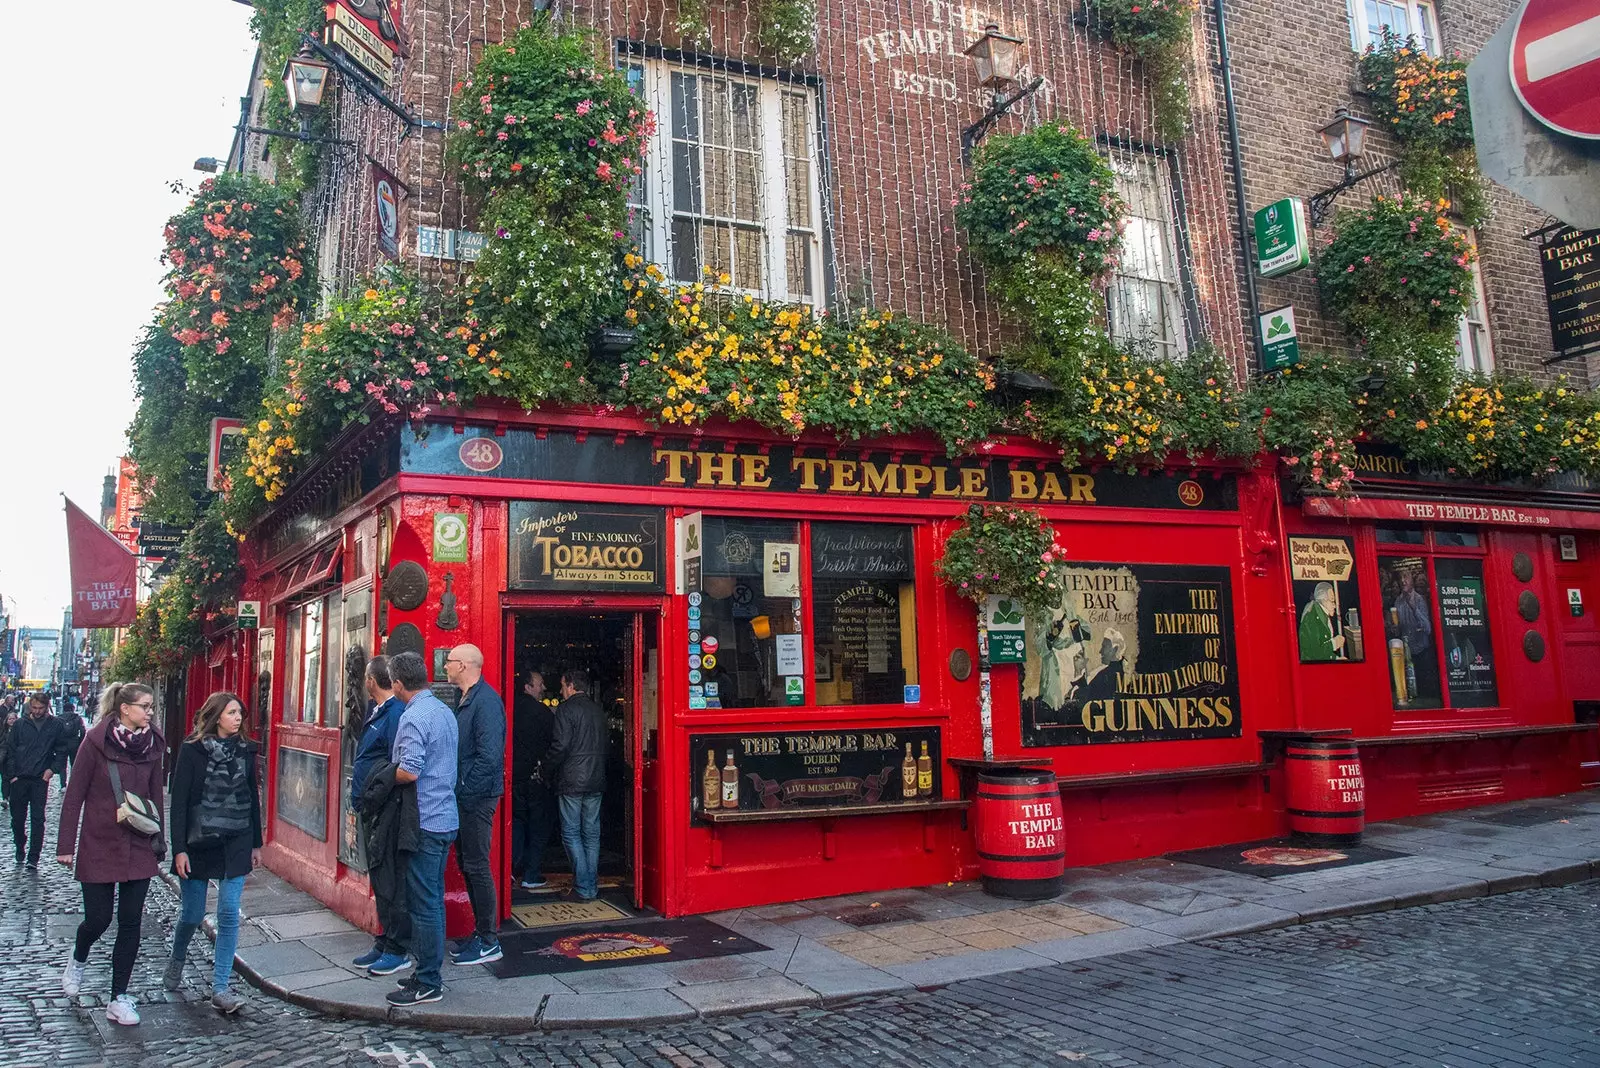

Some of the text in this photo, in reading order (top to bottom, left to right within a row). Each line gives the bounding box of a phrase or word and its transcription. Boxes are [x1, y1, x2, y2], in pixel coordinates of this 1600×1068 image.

[348, 16, 383, 52] DUBLIN
[340, 33, 361, 58] LIVE
[363, 54, 389, 81] MUSIC
[1561, 230, 1584, 241] THE
[1271, 256, 1285, 266] TEMPLE
[1285, 253, 1295, 261] BAR
[1560, 252, 1594, 271] BAR
[1551, 289, 1574, 301] BEER
[1557, 319, 1579, 331] LIVE
[1571, 323, 1600, 337] DAILY
[653, 450, 1097, 502] THE TEMPLE BAR
[1181, 485, 1198, 502] 48
[1406, 503, 1435, 518] THE
[1436, 505, 1490, 521] TEMPLE
[1491, 508, 1517, 522] BAR
[515, 511, 578, 536] Importers
[554, 525, 567, 533] OF
[571, 531, 642, 543] FINE SMOKING
[1291, 540, 1310, 553] Beer
[1311, 541, 1340, 554] Garden
[532, 536, 643, 576] TOBACCO
[1293, 554, 1326, 568] Smoking
[555, 570, 652, 581] Always in Stock
[1301, 567, 1320, 578] Area
[92, 582, 116, 590] THE
[1060, 574, 1135, 592] TEMPLE
[76, 587, 133, 601] TEMPLE
[834, 586, 896, 606] TEMPLE BAR
[1459, 587, 1476, 595] miles
[91, 600, 120, 611] BAR
[1083, 592, 1120, 611] BAR
[1188, 589, 1218, 610] THE
[1461, 597, 1475, 606] Still
[1444, 607, 1480, 616] local at The
[1154, 613, 1220, 635] EMPEROR
[1445, 617, 1483, 628] Temple Bar.
[1204, 638, 1221, 659] OF
[1115, 660, 1228, 695] MALTED LIQUORS
[1081, 696, 1234, 733] GUINNESS
[741, 733, 899, 756] THE TEMPLE BAR
[804, 754, 841, 765] DUBLIN
[807, 766, 838, 775] EST. 1840
[1338, 763, 1361, 777] THE
[786, 782, 859, 794] LIVE MUSIC DAILY
[1342, 790, 1364, 803] BAR
[1021, 803, 1053, 818] THE
[1008, 816, 1063, 835] TEMPLE
[1025, 834, 1056, 849] BAR
